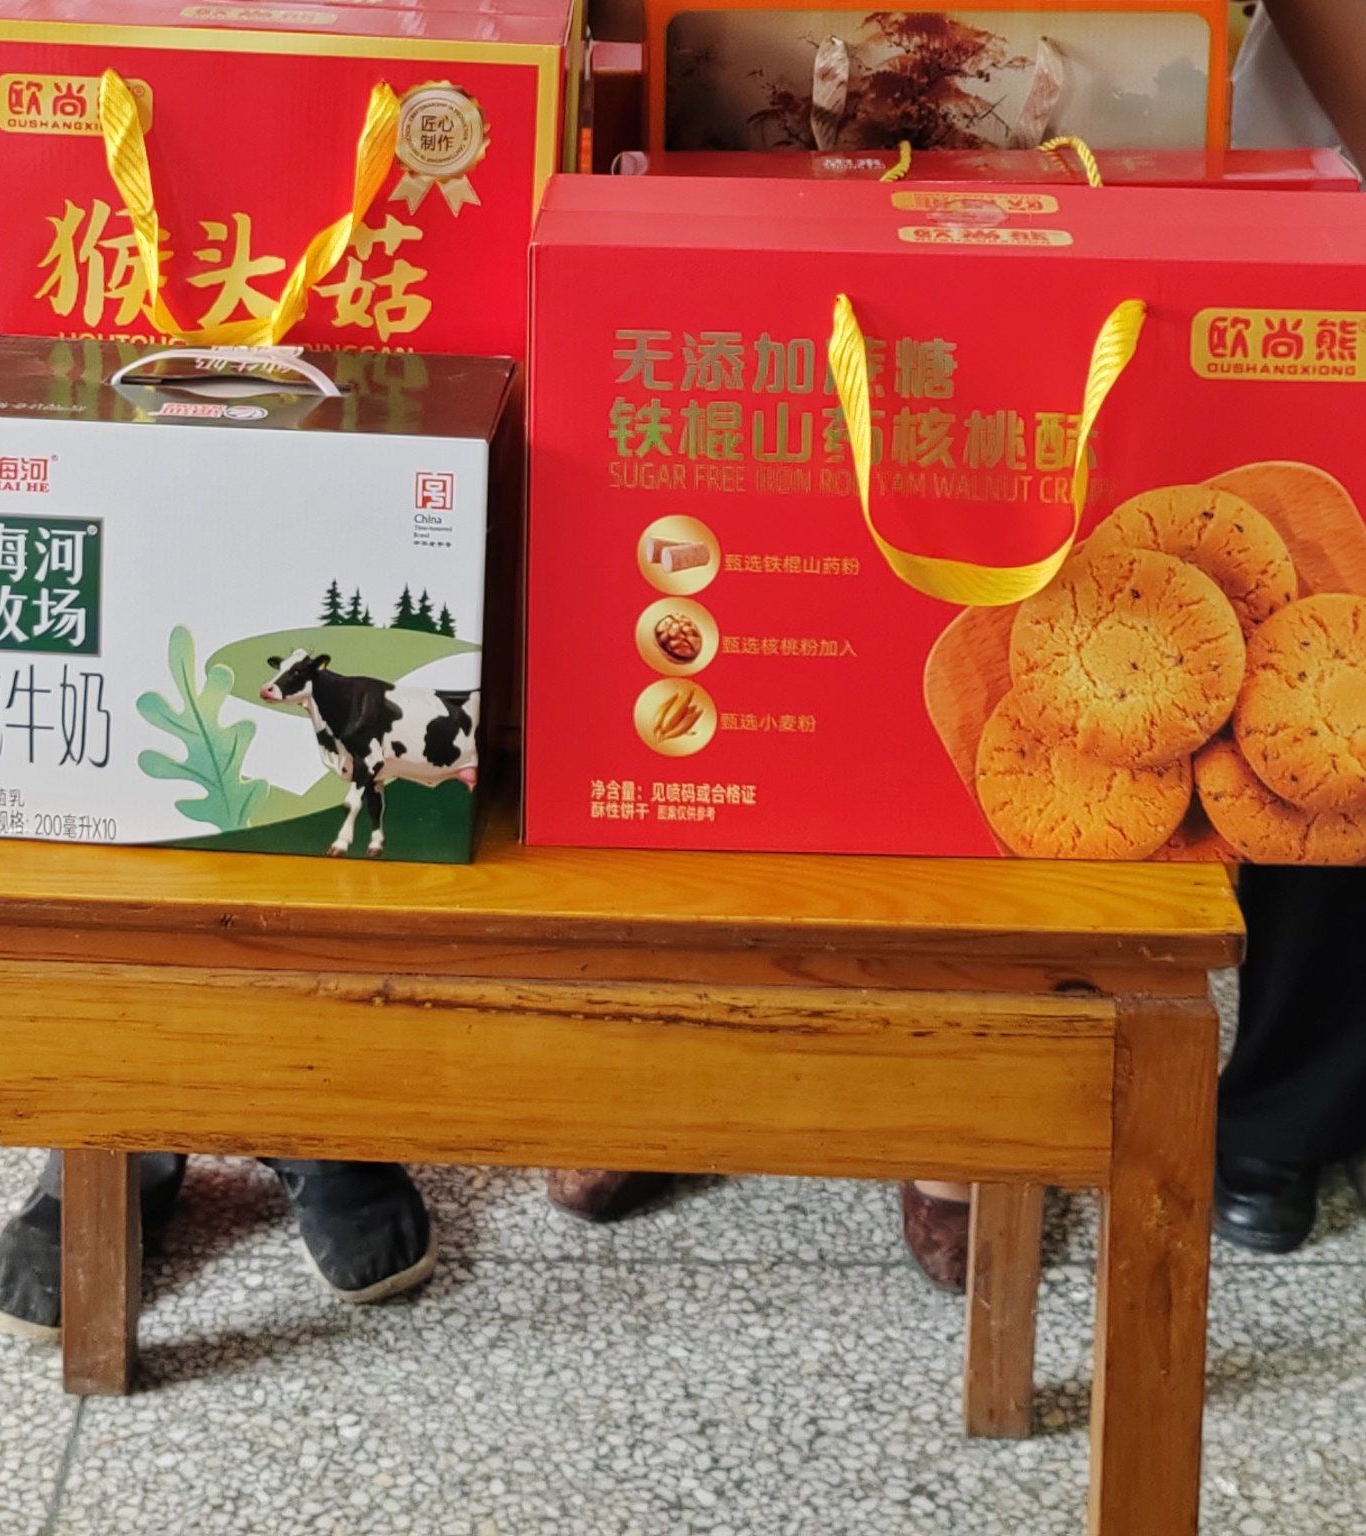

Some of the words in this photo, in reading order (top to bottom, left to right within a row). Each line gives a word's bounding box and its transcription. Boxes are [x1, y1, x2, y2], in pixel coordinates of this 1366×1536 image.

[8, 80, 109, 119] 欧尚
[421, 114, 456, 133] 匠心
[420, 134, 455, 152] 制作
[35, 199, 434, 343] 猴头菇
[1208, 316, 1357, 361] 欧尚熊
[1206, 363, 1357, 377] OUSHANGXIONG
[26, 482, 50, 493] HE
[608, 461, 687, 490] SUGAR
[694, 465, 746, 493] FREE
[933, 473, 1033, 502] WALNUT
[724, 554, 861, 576] 甄选铁棍山药粉
[722, 636, 857, 658] 甄选核桃粉加入
[720, 713, 817, 734] 甄选小麦粉
